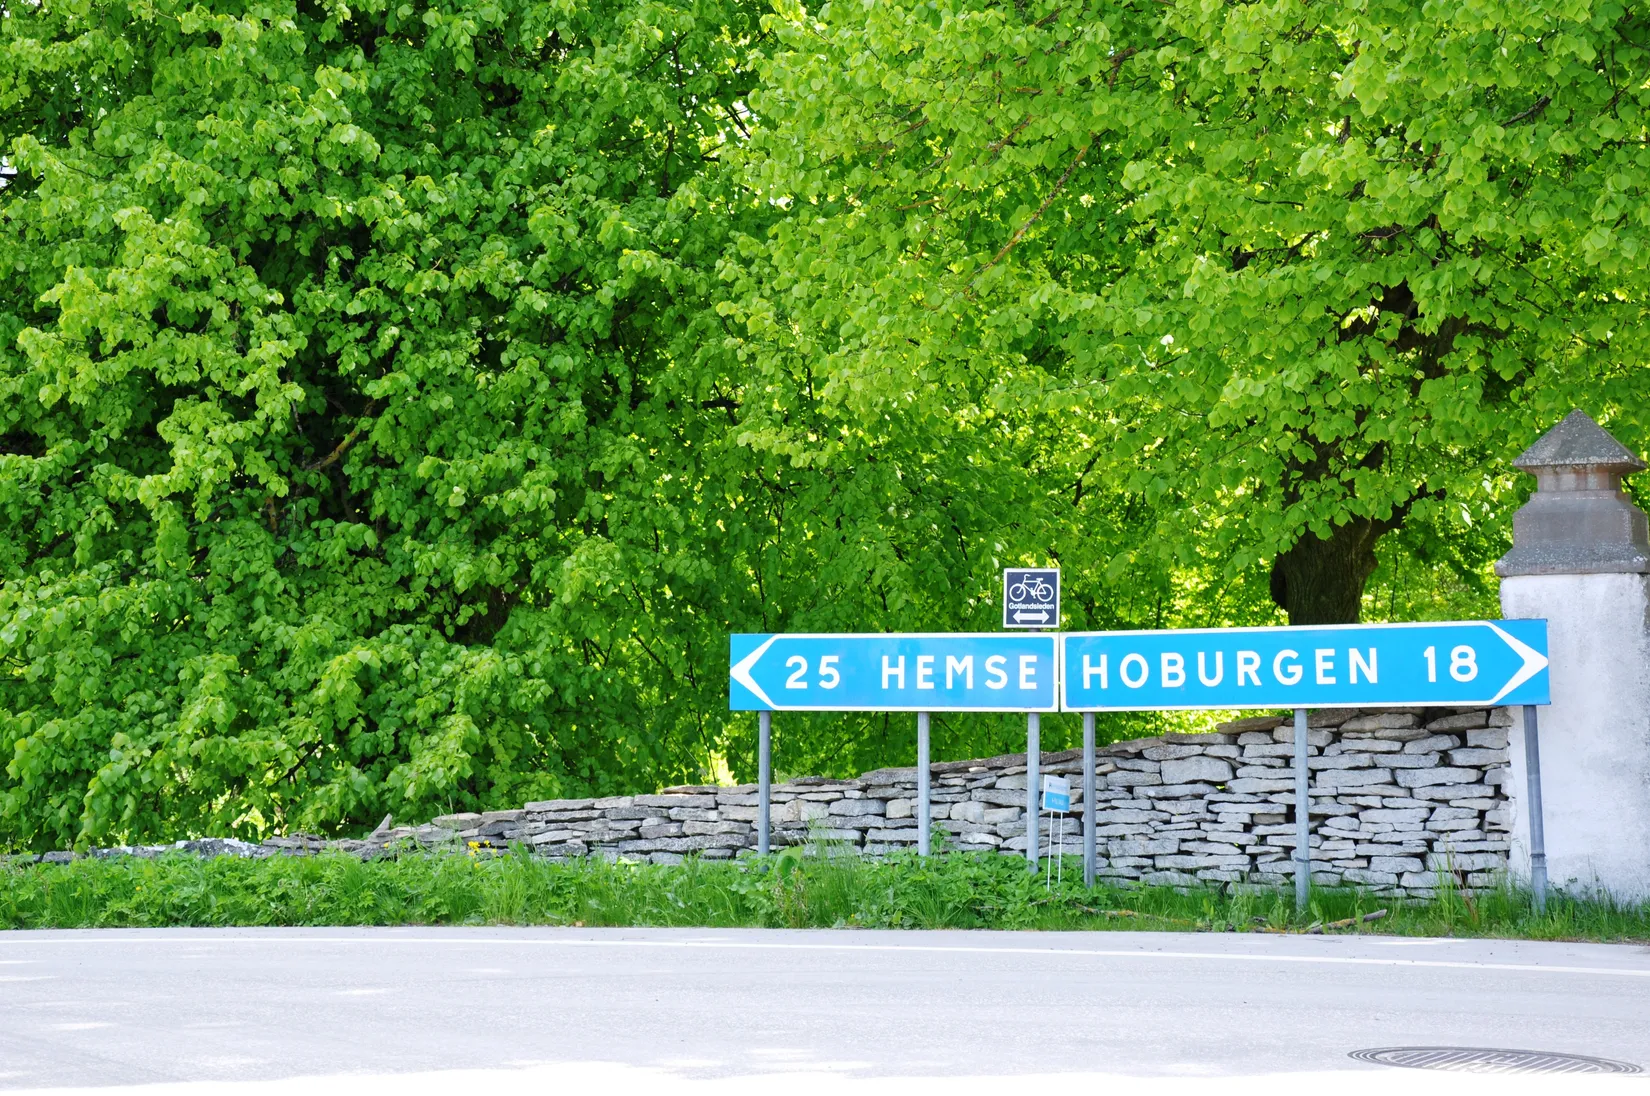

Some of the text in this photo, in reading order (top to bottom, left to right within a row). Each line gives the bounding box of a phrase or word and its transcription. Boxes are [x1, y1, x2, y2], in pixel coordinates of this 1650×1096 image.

[1008, 602, 1055, 610] Gotlandsleden
[785, 653, 1040, 691] 25 HEMSE
[1082, 644, 1480, 691] HOBURGEN 18
